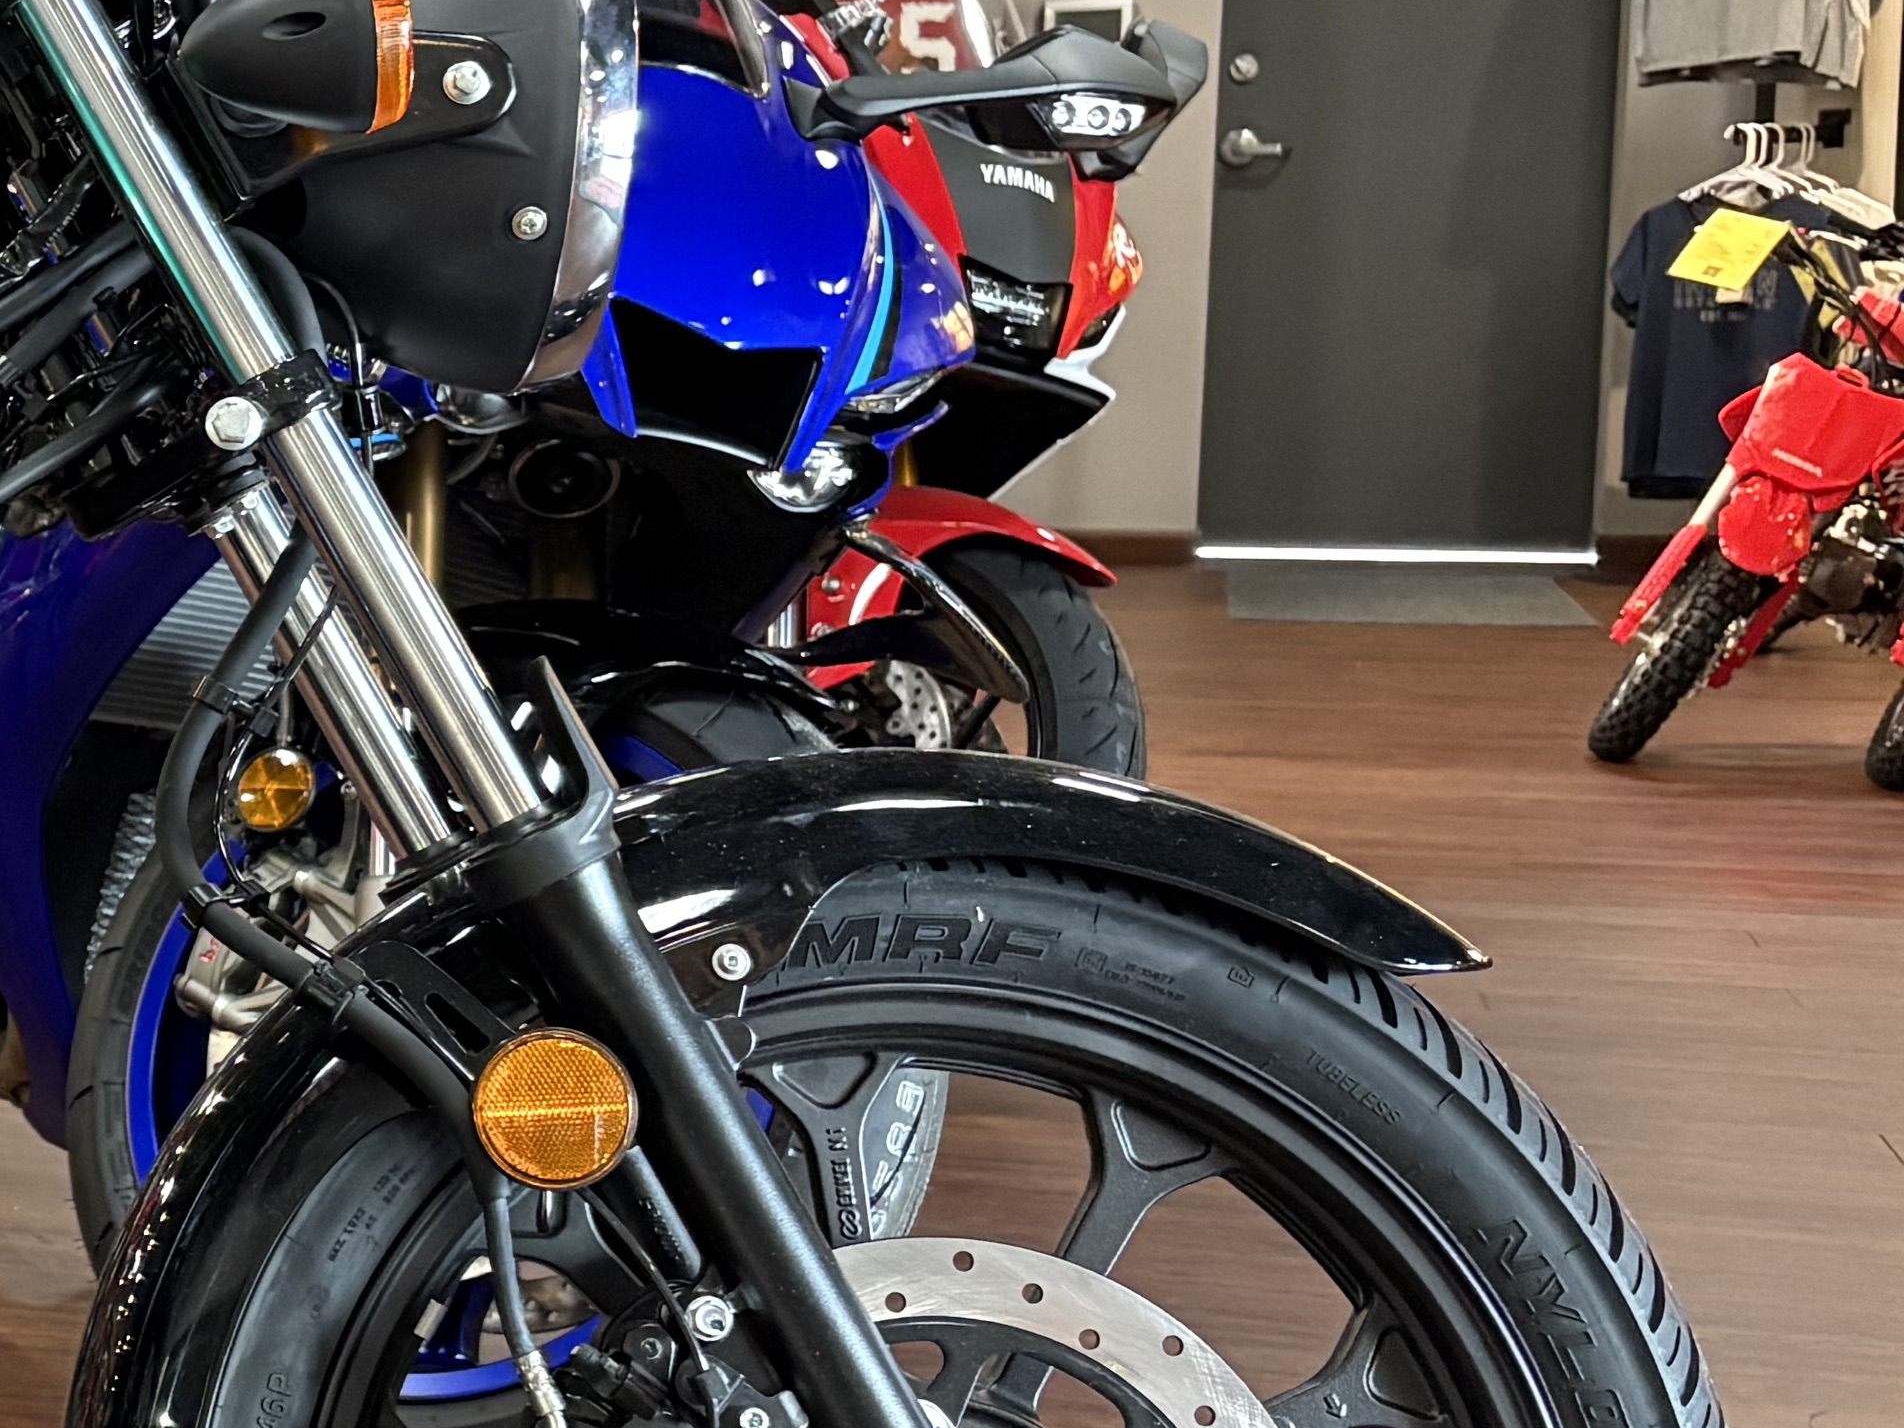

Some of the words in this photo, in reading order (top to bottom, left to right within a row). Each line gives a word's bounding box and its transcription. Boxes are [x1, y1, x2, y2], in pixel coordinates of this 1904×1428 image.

[980, 163, 1055, 203] YAMAHA
[790, 912, 1063, 969] MRF
[1304, 1048, 1405, 1126] TUBELESS
